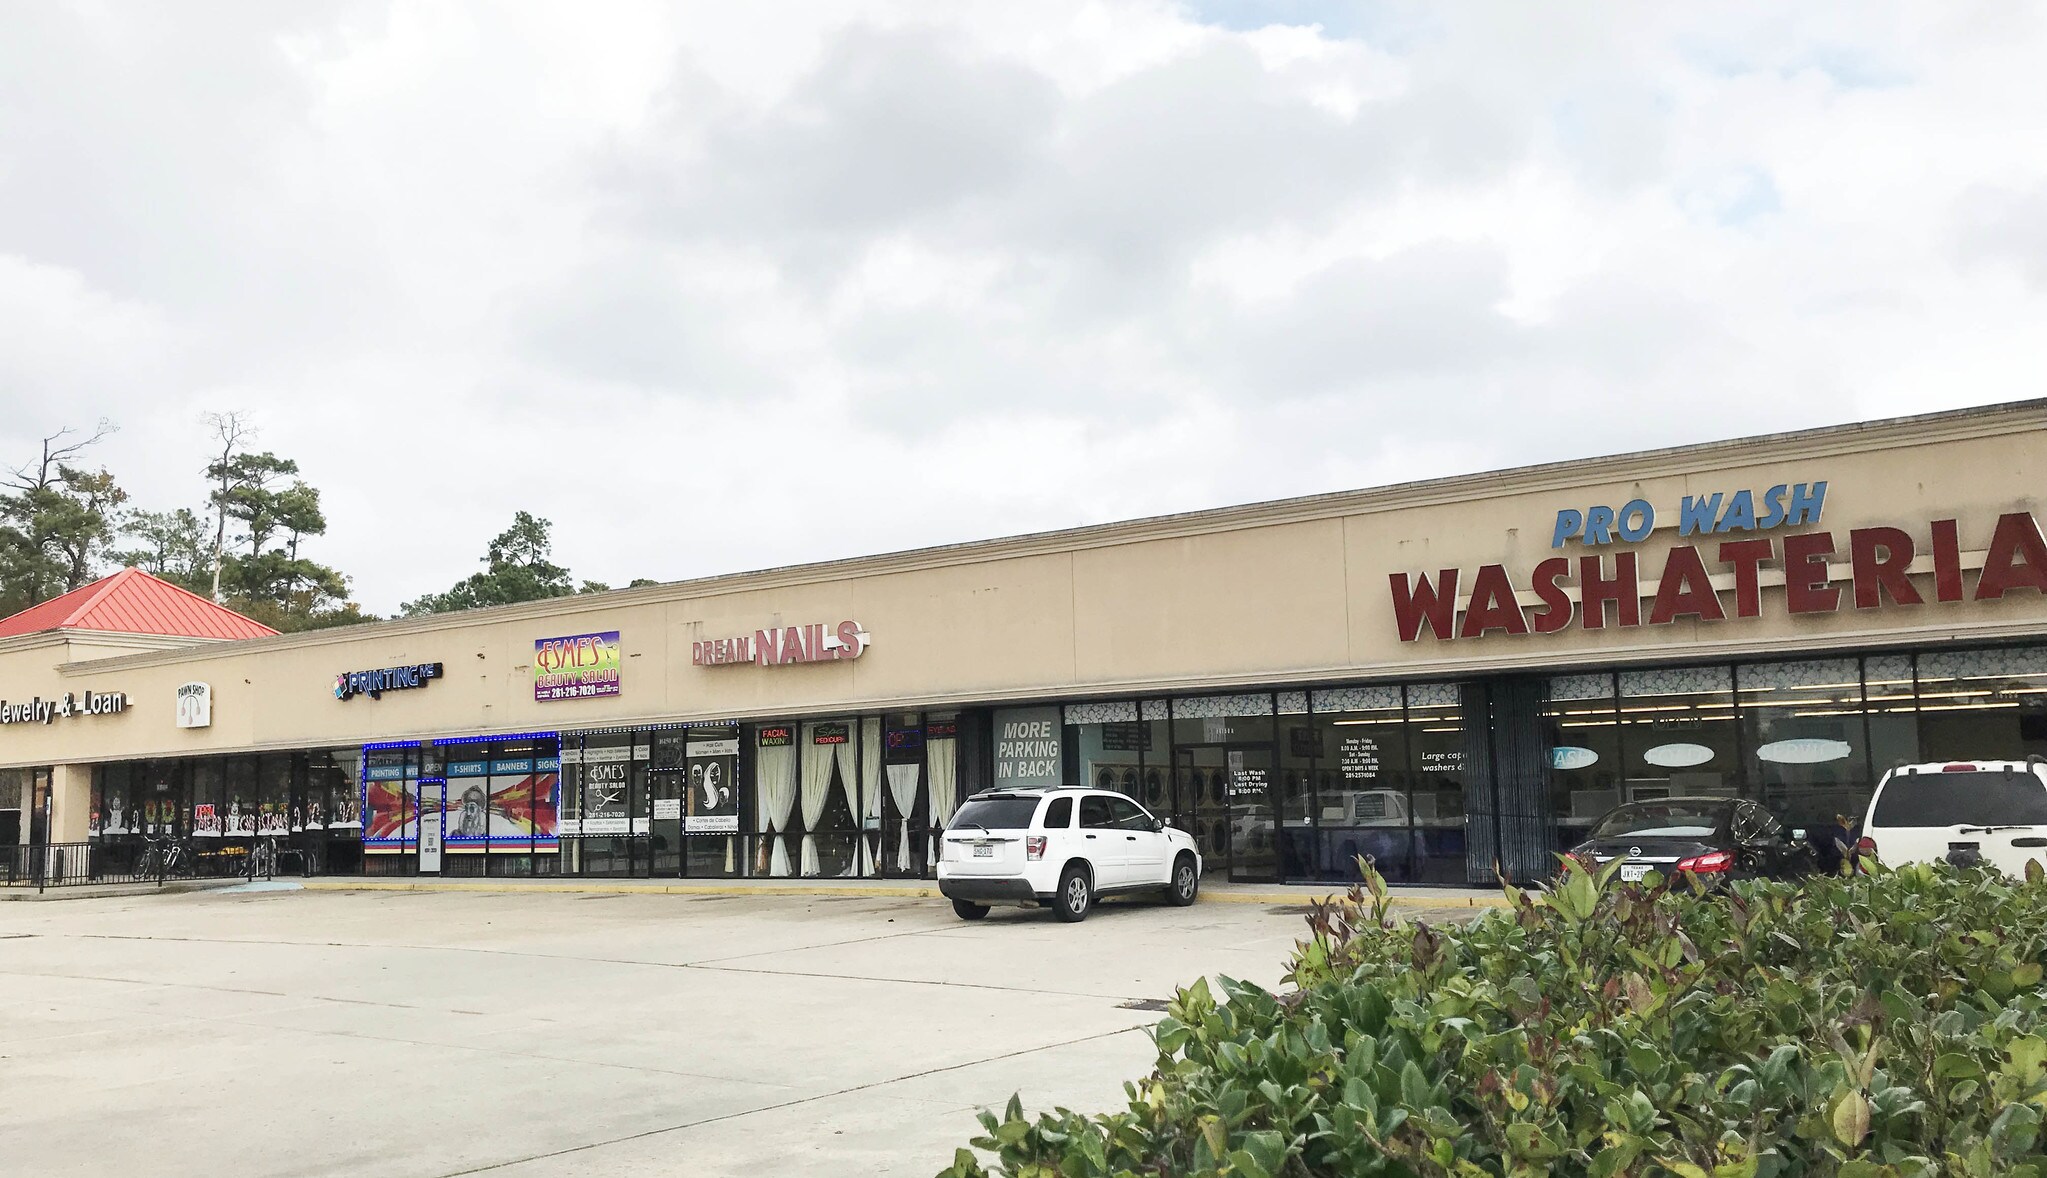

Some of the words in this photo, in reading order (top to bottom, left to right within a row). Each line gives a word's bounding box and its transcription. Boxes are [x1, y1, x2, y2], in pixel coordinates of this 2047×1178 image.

[1551, 499, 1656, 548] PRO
[1679, 480, 1829, 537] WASH
[1388, 511, 2047, 642] WASHATERIA
[755, 620, 863, 666] NAILS
[537, 636, 601, 674] ESME'S
[348, 665, 418, 698] PRINTING
[538, 672, 577, 688] BEAUTY
[581, 668, 617, 684] SALON
[178, 685, 191, 698] PAWN
[193, 684, 204, 696] SHOP
[551, 684, 596, 698] 281-216-7020
[0, 697, 53, 724] ewelry
[60, 692, 74, 718] &
[82, 690, 124, 715] Loan
[762, 729, 789, 738] FACIAL
[1003, 721, 1052, 739] MORE
[998, 740, 1058, 758] PARKING
[1421, 751, 1445, 762] Large
[371, 768, 400, 778] PRINTING
[424, 763, 443, 772] OPEN
[454, 764, 482, 773] T-SHIRTS
[496, 761, 528, 771] BANNERS
[537, 760, 559, 769] SIGNS
[590, 764, 624, 782] ESME'S
[998, 761, 1013, 778] IN
[1017, 760, 1056, 778] BACK
[1422, 763, 1455, 772] washers
